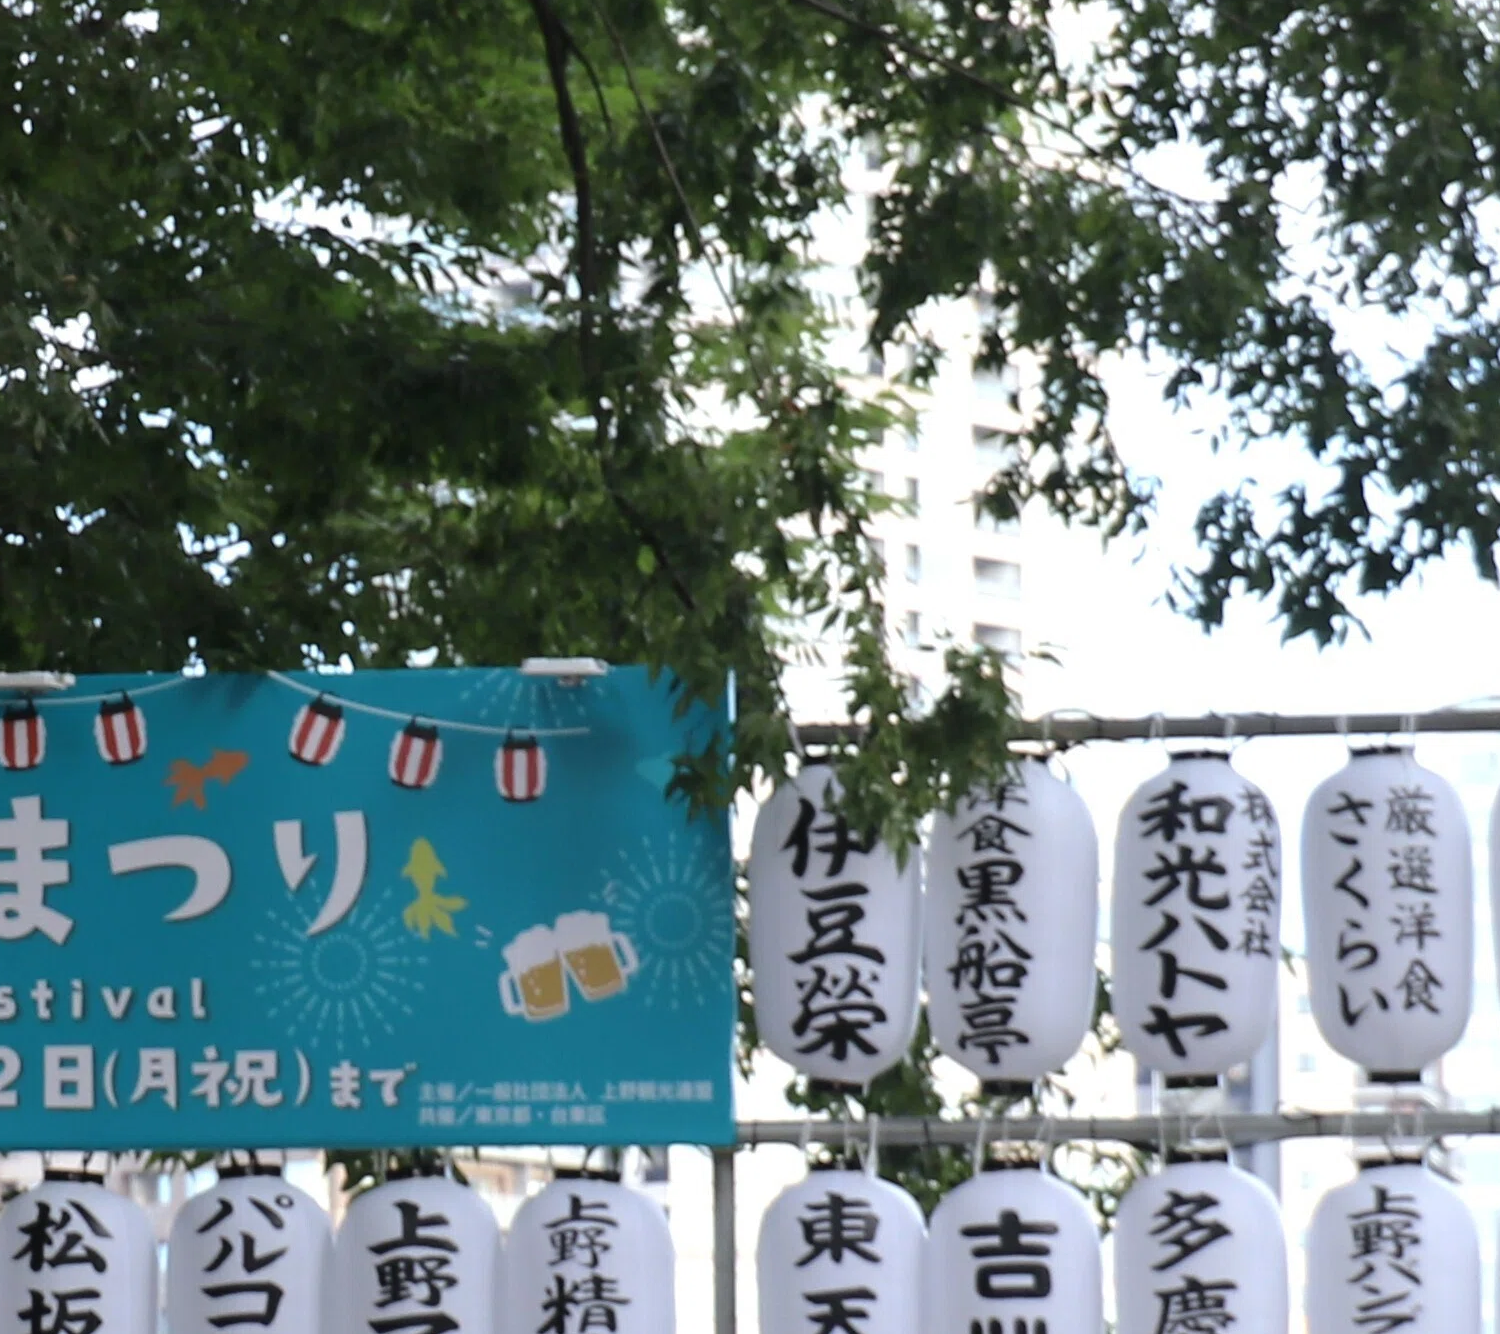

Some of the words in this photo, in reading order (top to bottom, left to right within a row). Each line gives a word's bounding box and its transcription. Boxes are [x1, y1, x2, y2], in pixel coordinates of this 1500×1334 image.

[1138, 780, 1229, 1060] 和光ハトヤ
[1235, 786, 1278, 958] 株式会社
[1327, 792, 1389, 1028] さくらい
[1383, 785, 1442, 1014] 厳選洋食
